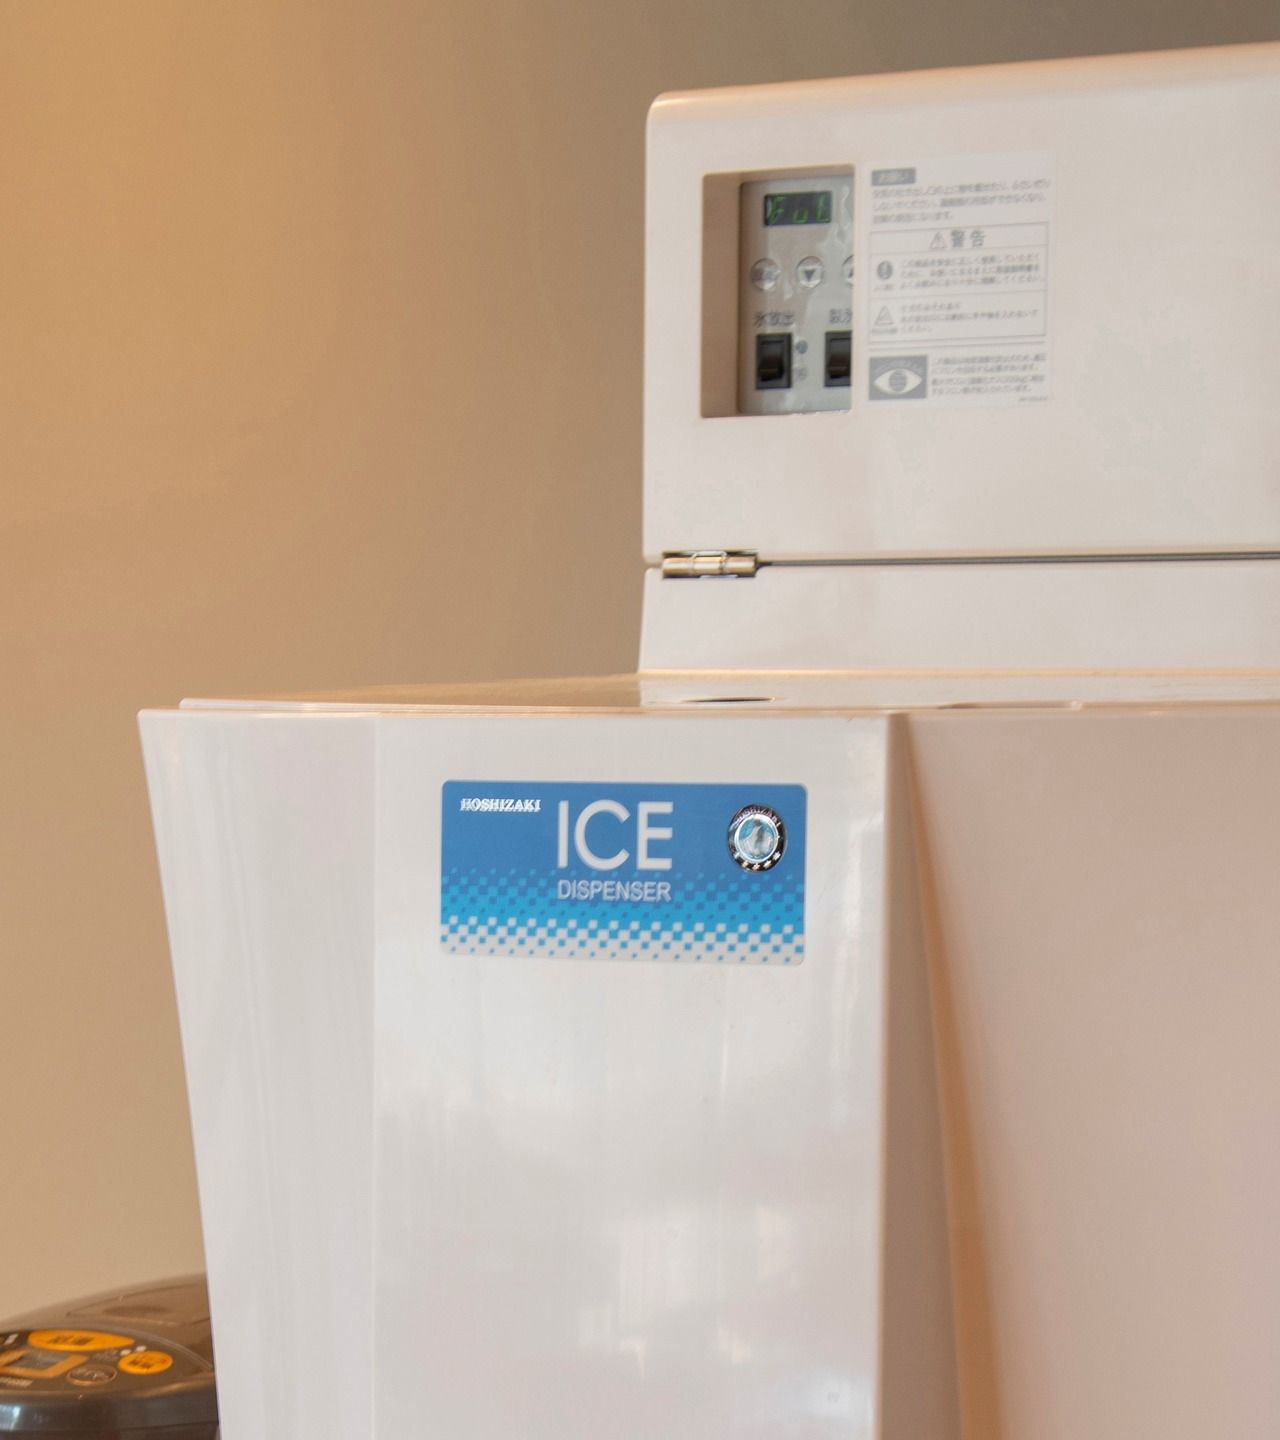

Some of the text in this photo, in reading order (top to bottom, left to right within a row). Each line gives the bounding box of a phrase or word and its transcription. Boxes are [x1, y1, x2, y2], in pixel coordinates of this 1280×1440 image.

[460, 797, 542, 813] HOSHIZAKI
[557, 799, 674, 871] ICE
[557, 879, 672, 903] DISPENSER
